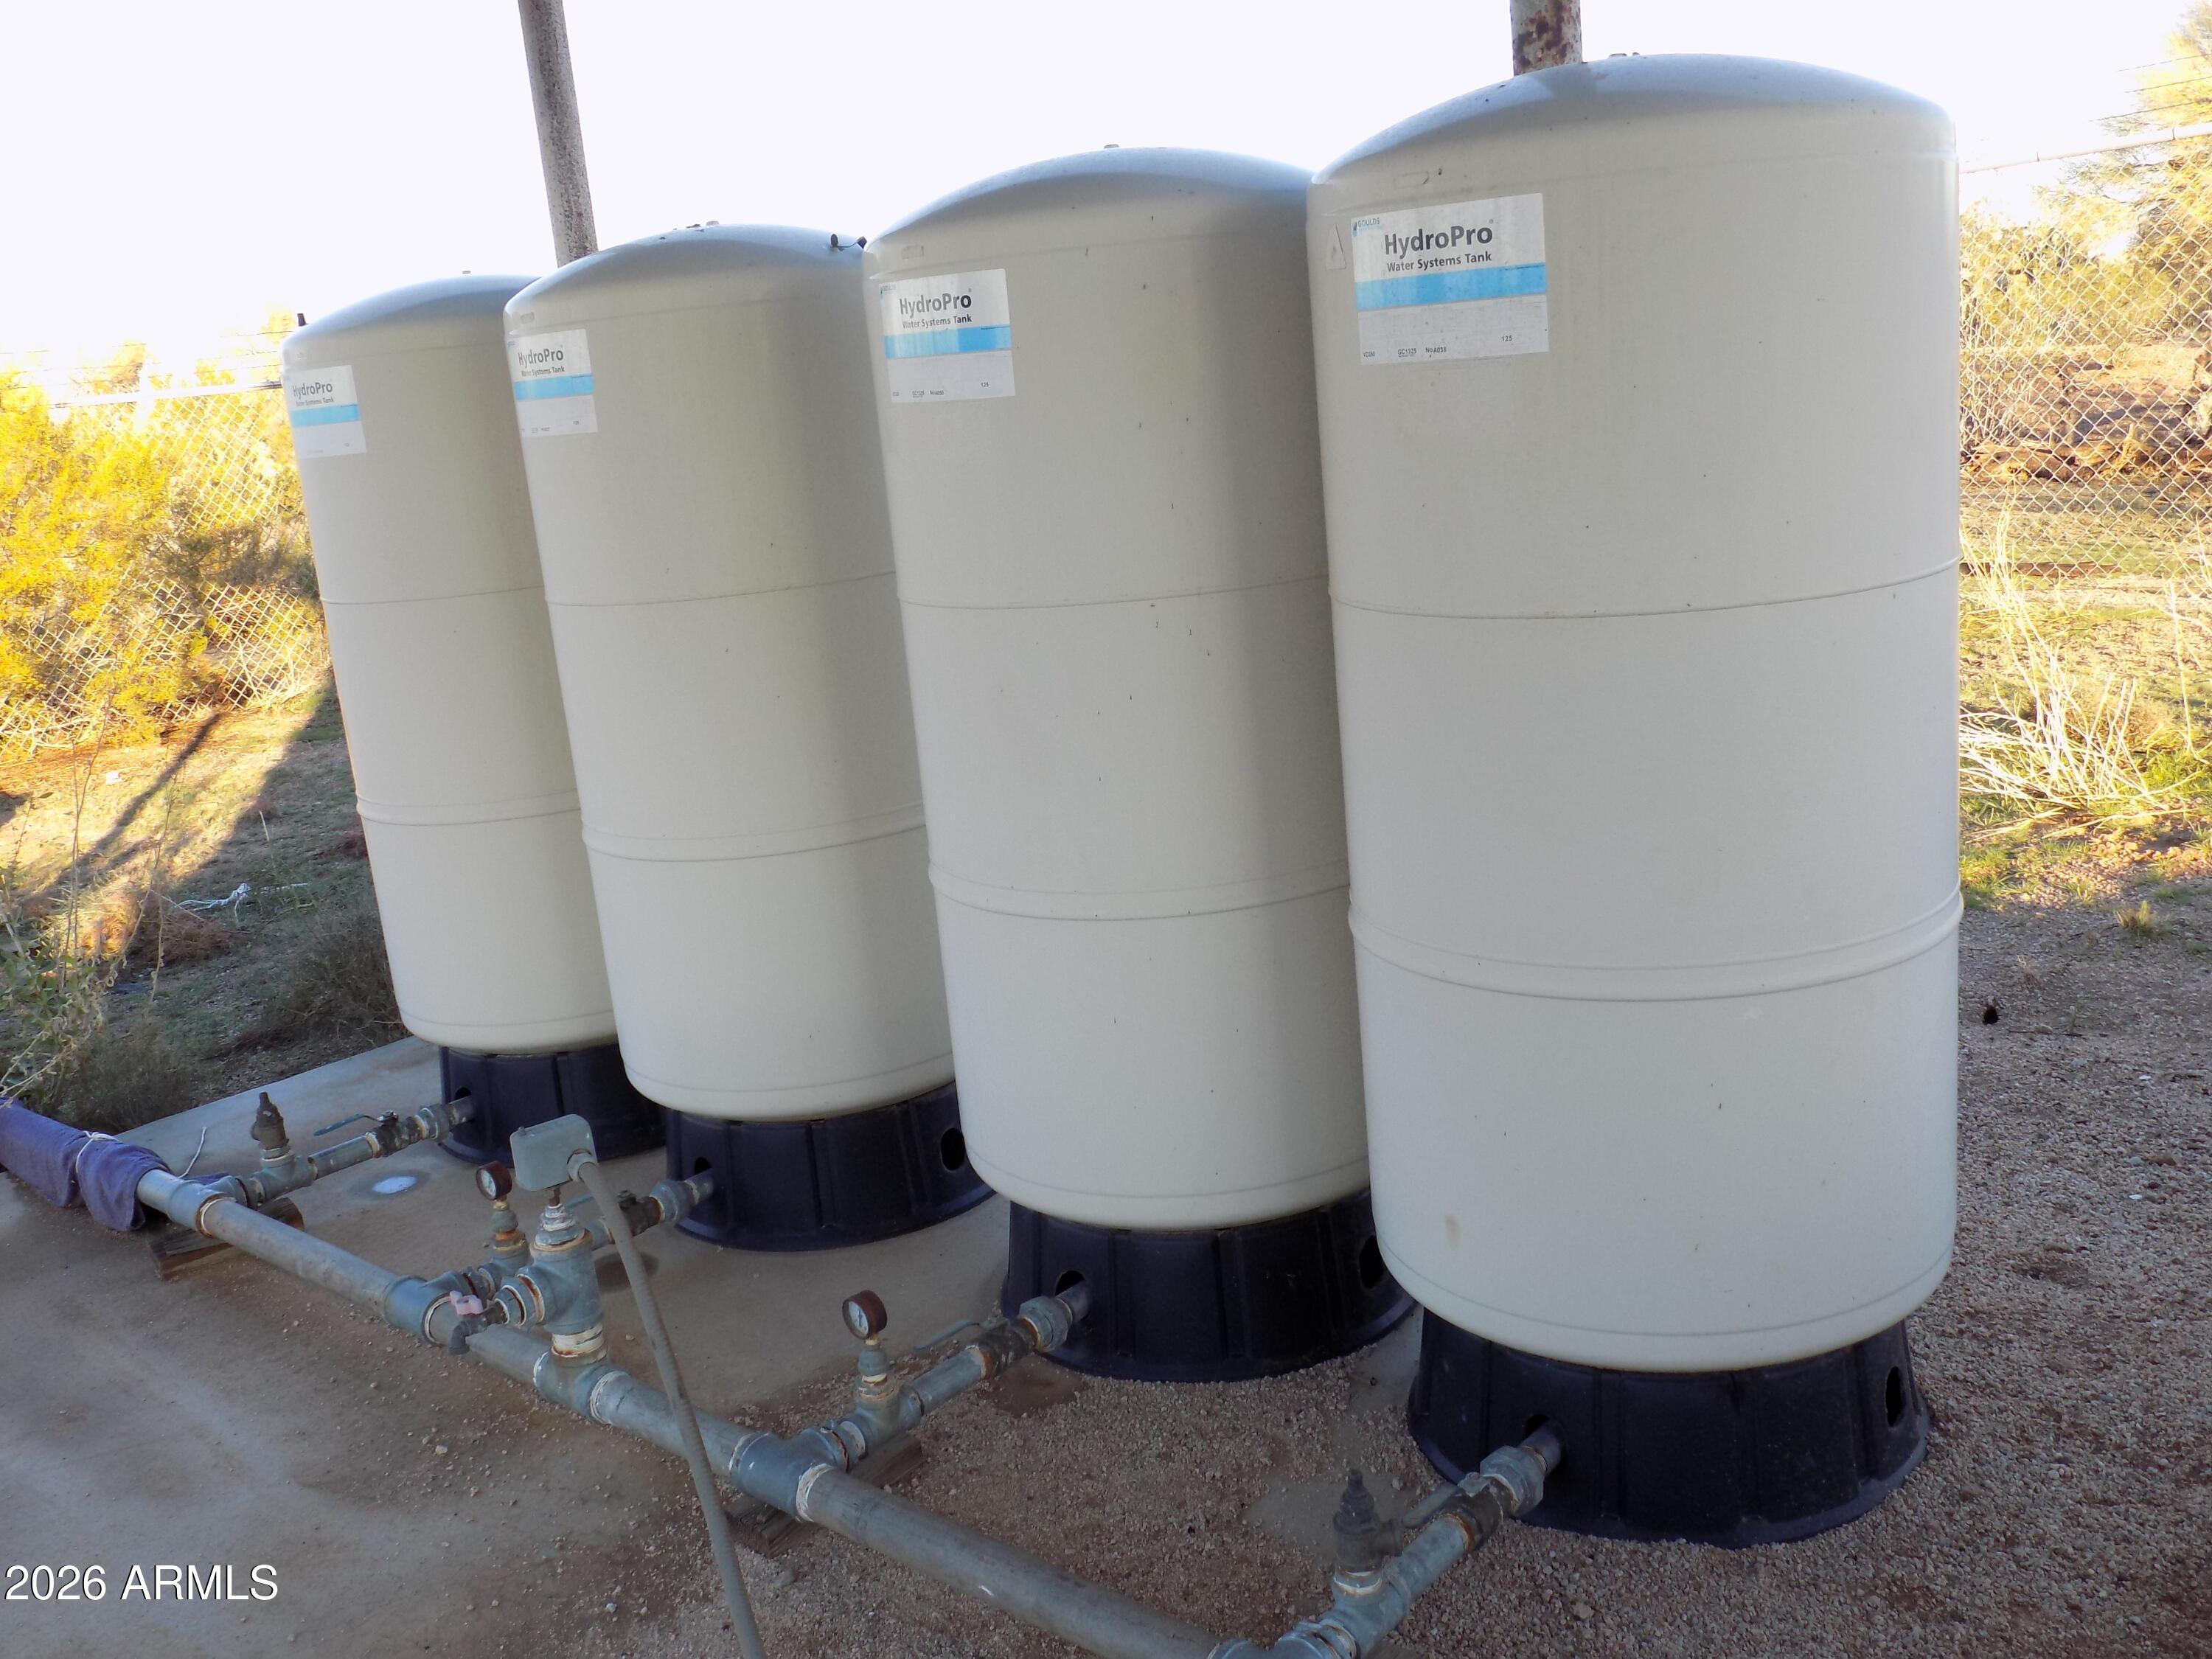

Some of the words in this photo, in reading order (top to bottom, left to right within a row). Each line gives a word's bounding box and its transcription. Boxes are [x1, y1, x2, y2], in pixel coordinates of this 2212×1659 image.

[1357, 218, 1380, 227] GOULDS
[1385, 225, 1493, 259] HydroPro
[1387, 260, 1414, 272] Water
[1417, 256, 1461, 271] Systems
[1464, 251, 1492, 263] Tank
[900, 293, 972, 319] HydroPro
[902, 320, 920, 329] Water
[922, 317, 951, 328] Systems
[953, 314, 973, 324] Tank
[518, 348, 563, 369] HydroPro
[293, 382, 333, 400] HydroPro
